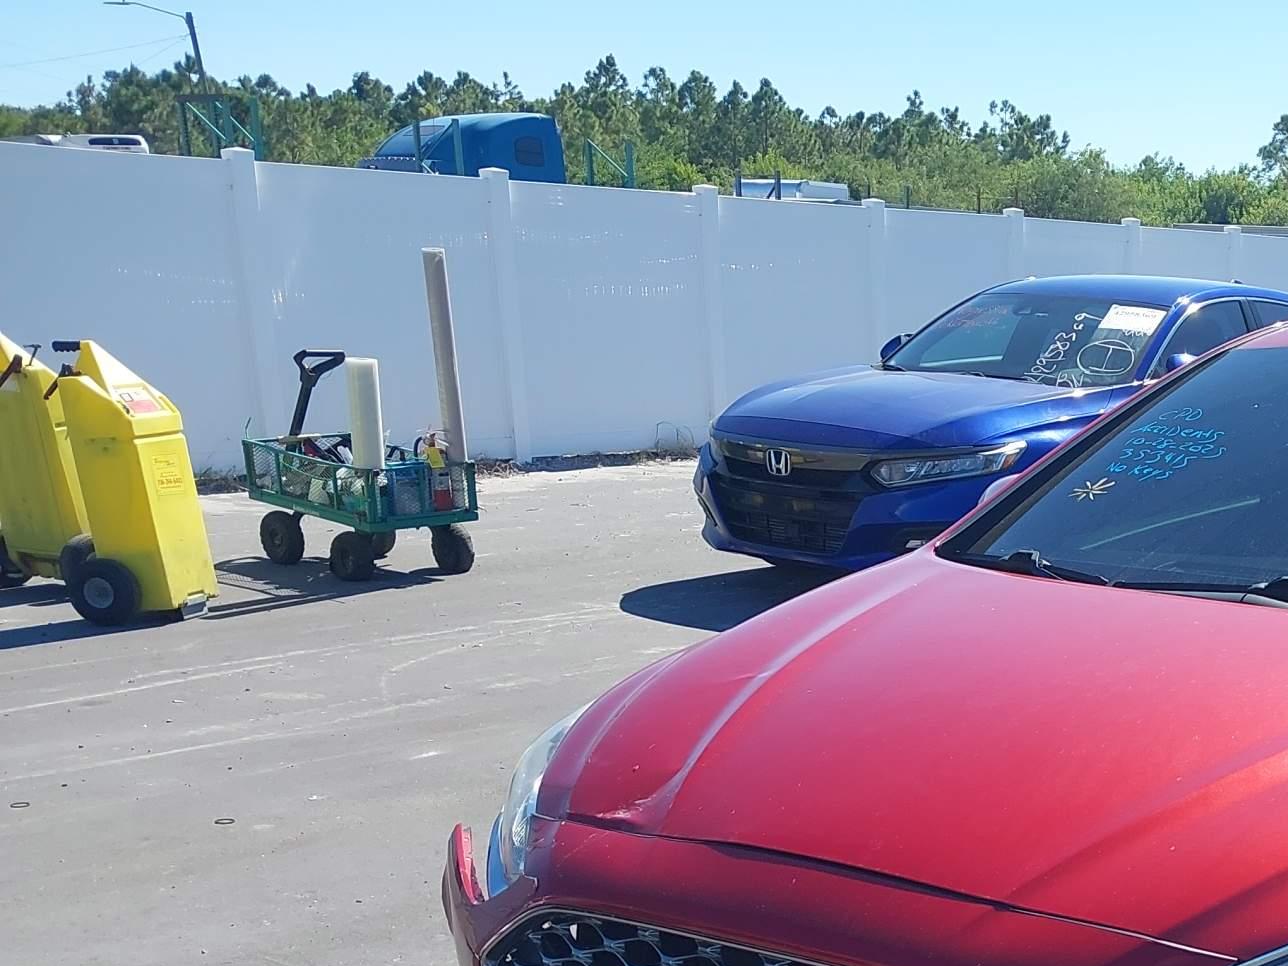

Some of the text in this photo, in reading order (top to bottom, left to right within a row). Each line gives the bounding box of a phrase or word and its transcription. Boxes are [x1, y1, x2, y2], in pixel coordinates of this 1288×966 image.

[1158, 406, 1203, 421] CPD
[1124, 437, 1227, 459] 10-28-2025
[1105, 461, 1176, 482] No Keys
